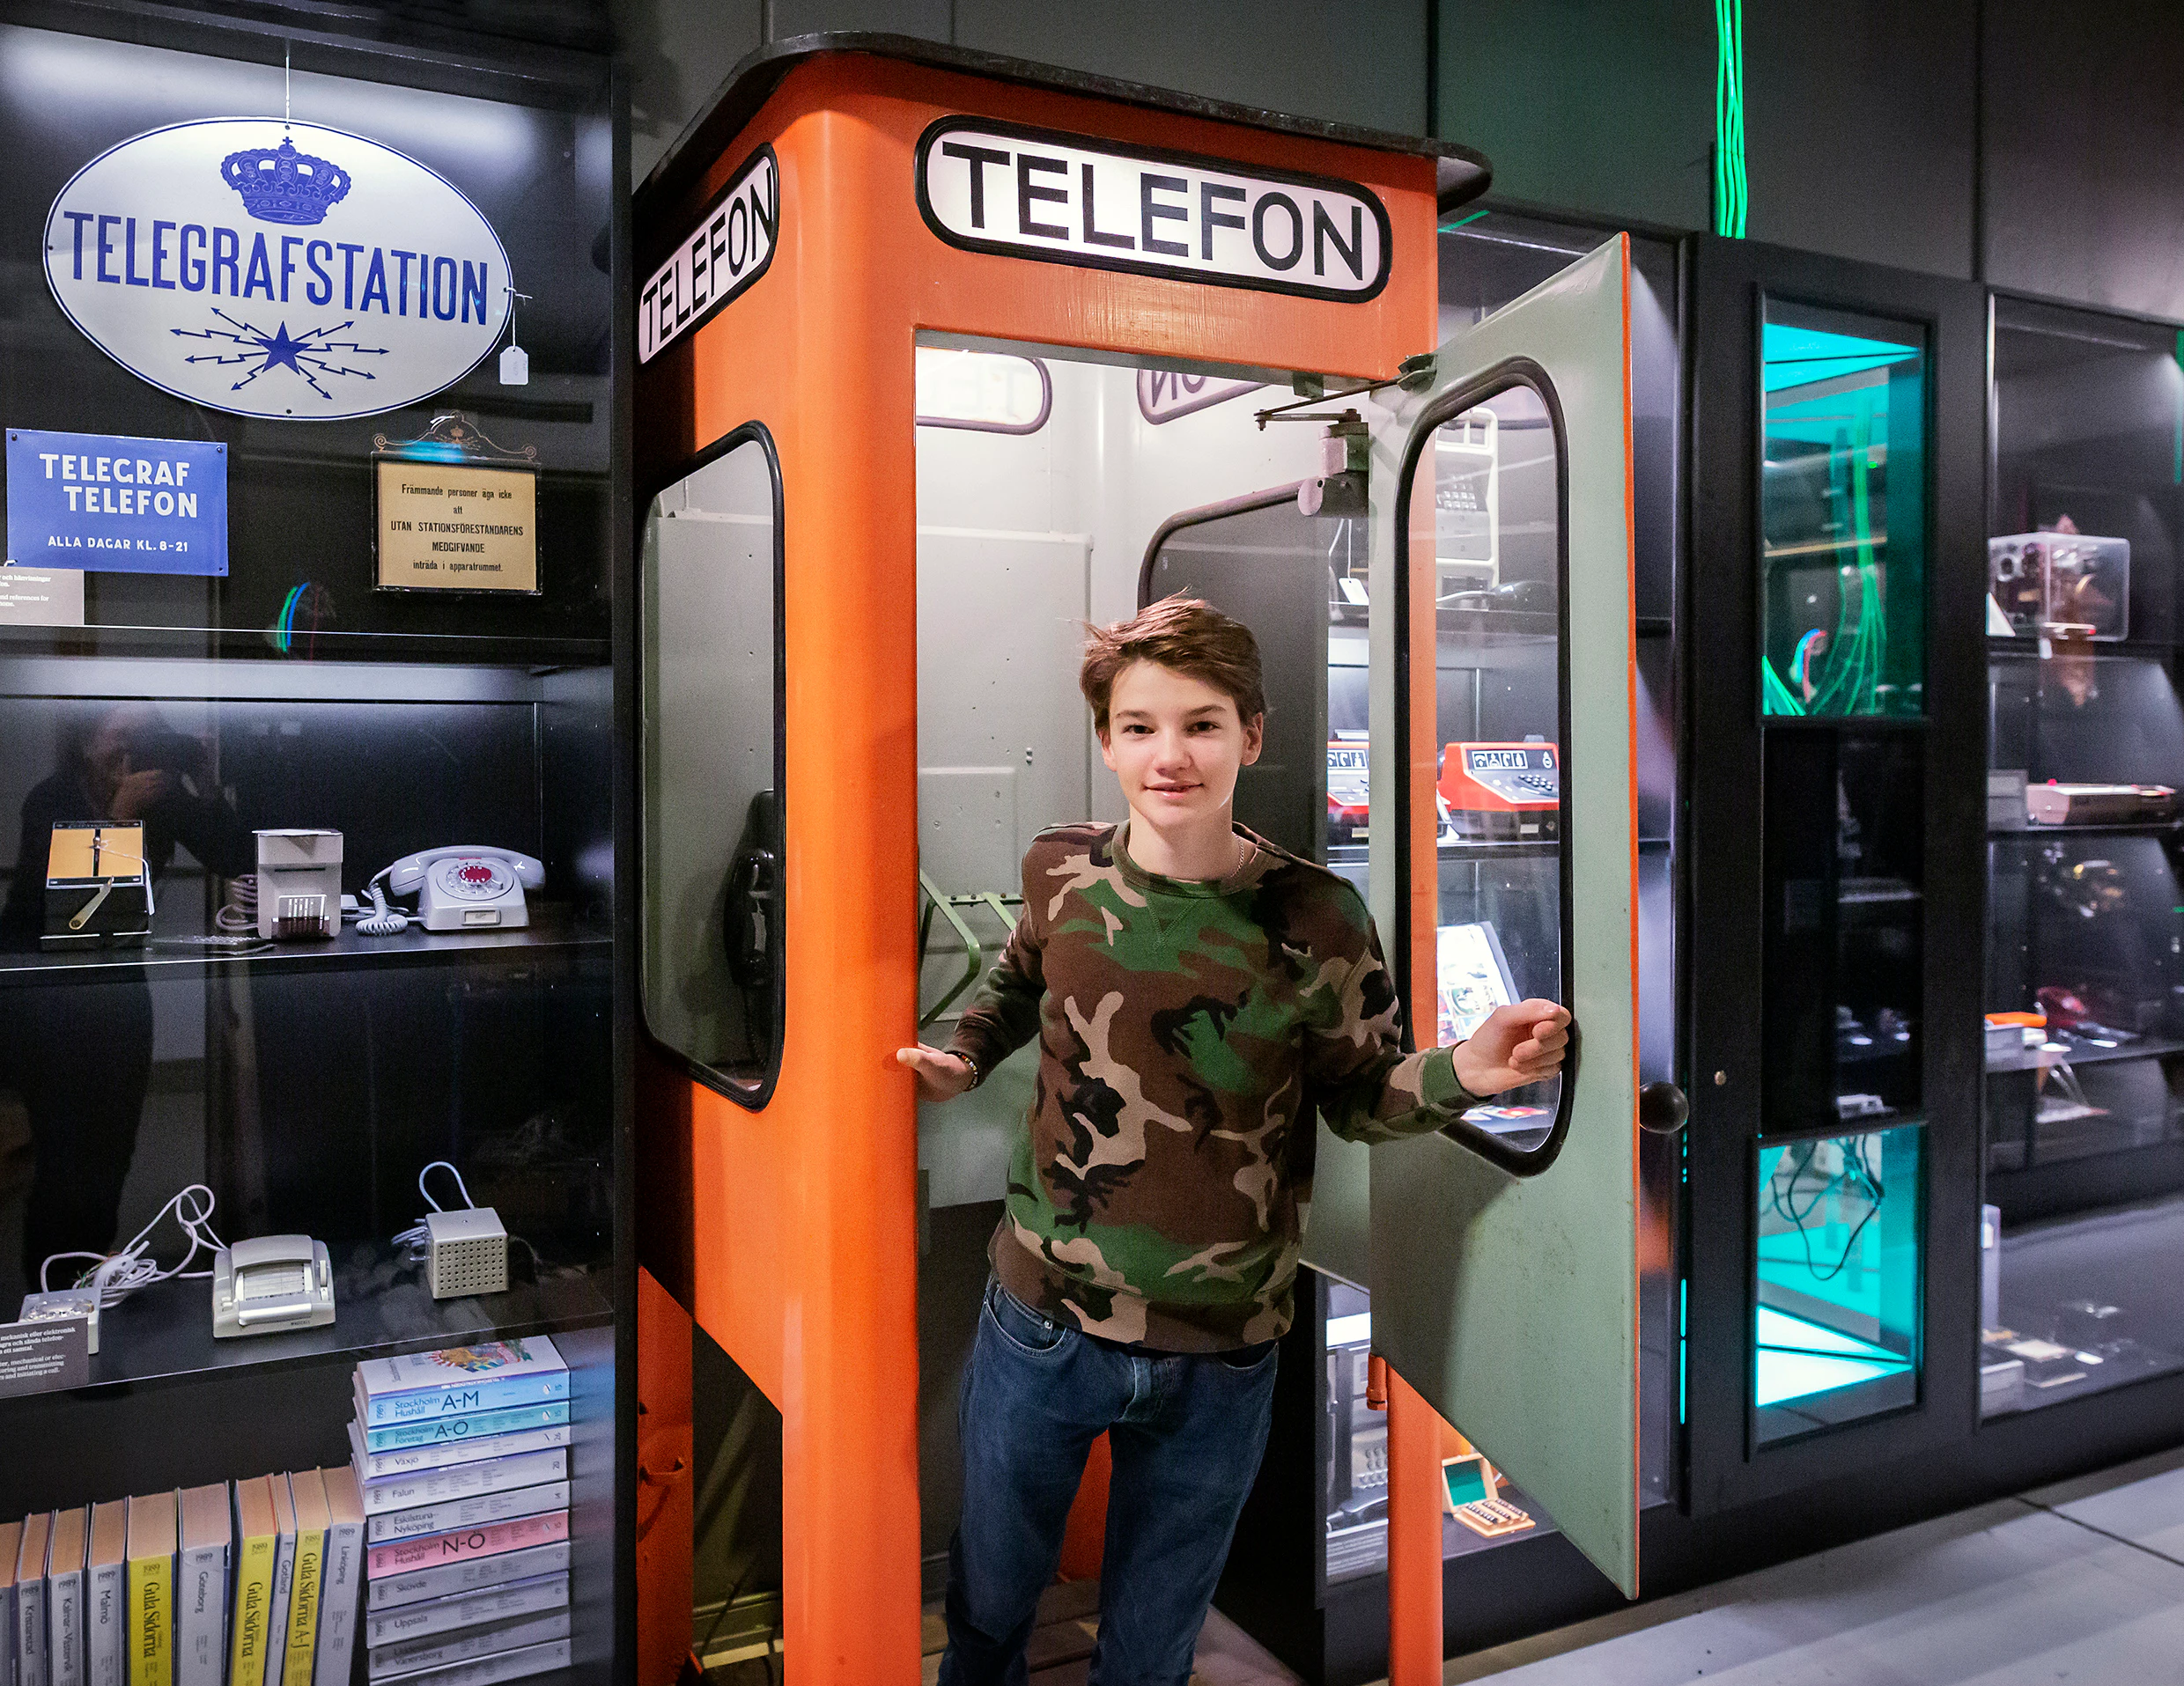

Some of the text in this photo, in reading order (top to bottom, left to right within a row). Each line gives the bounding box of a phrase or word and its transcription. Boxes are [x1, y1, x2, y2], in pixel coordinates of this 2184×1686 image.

[941, 140, 1364, 281] TELEFON
[63, 210, 488, 326] TELEGRAFSTATION
[642, 166, 773, 354] TELEFON
[39, 453, 190, 487] TELEGRAF
[63, 485, 197, 519] TELEFON
[402, 483, 512, 501] Främmande personer äga icke
[454, 506, 462, 515] att
[390, 520, 411, 532] UTAN
[48, 535, 188, 552] ALLA DAGAR KL. 8-21
[432, 541, 485, 554] MEDGIFVANDE
[413, 559, 438, 570] inträda
[449, 562, 503, 572] apparatrummet.
[43, 1327, 76, 1336] elektronisk
[11, 1356, 44, 1366] mechanical
[395, 1390, 479, 1411] Stockholm A-M
[434, 1419, 469, 1439] A-Ö
[392, 1489, 415, 1498] Falun
[442, 1530, 485, 1556] N-Ö
[279, 1559, 291, 1594] Gotland
[300, 1552, 318, 1580] Gula
[100, 1589, 111, 1624] Malmö
[144, 1581, 160, 1611] Gula
[246, 1581, 263, 1610] Gula
[297, 1580, 315, 1627] Sidorna
[144, 1610, 160, 1659] Sidorna
[241, 1609, 262, 1658] Sidorna
